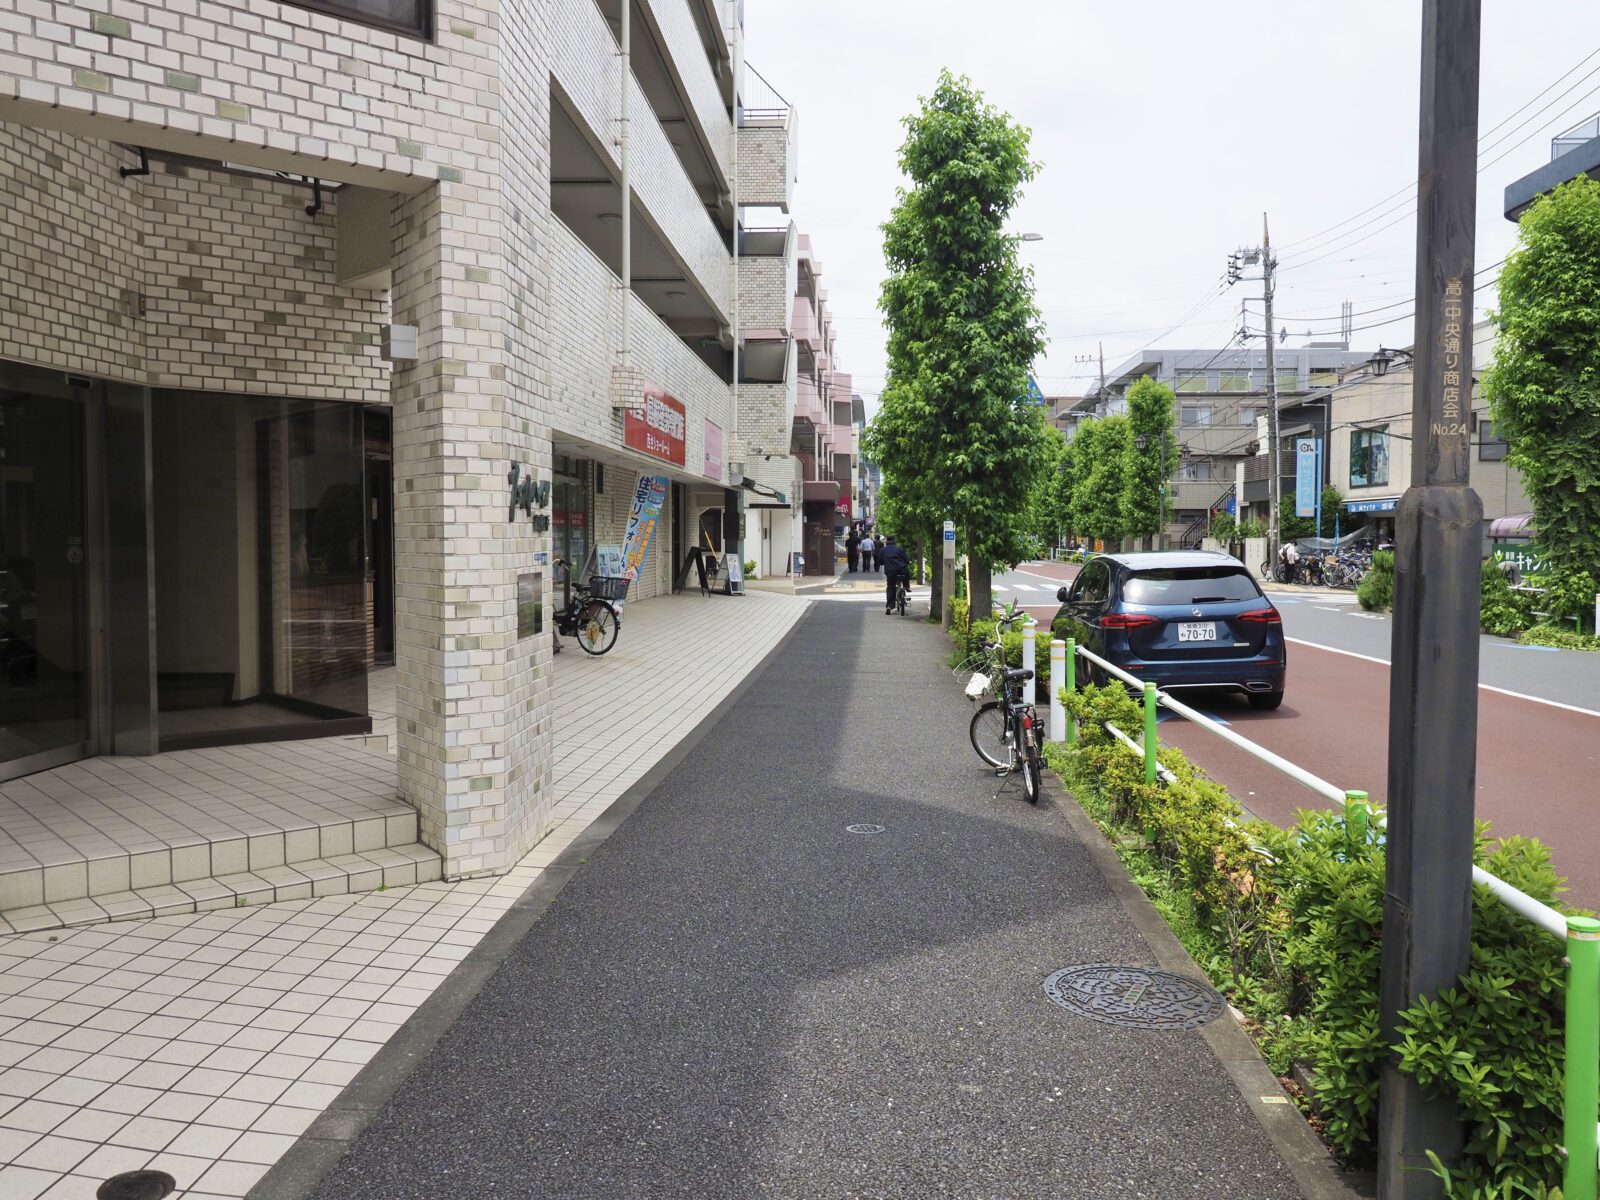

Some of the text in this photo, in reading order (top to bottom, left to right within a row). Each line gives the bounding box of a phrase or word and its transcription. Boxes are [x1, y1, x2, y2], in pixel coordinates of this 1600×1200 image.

[1443, 281, 1462, 418] 高一中央通り商店会
[1433, 423, 1467, 435] No.24
[621, 476, 651, 568] 住宅リフォーム
[1186, 629, 1214, 639] 70-70
